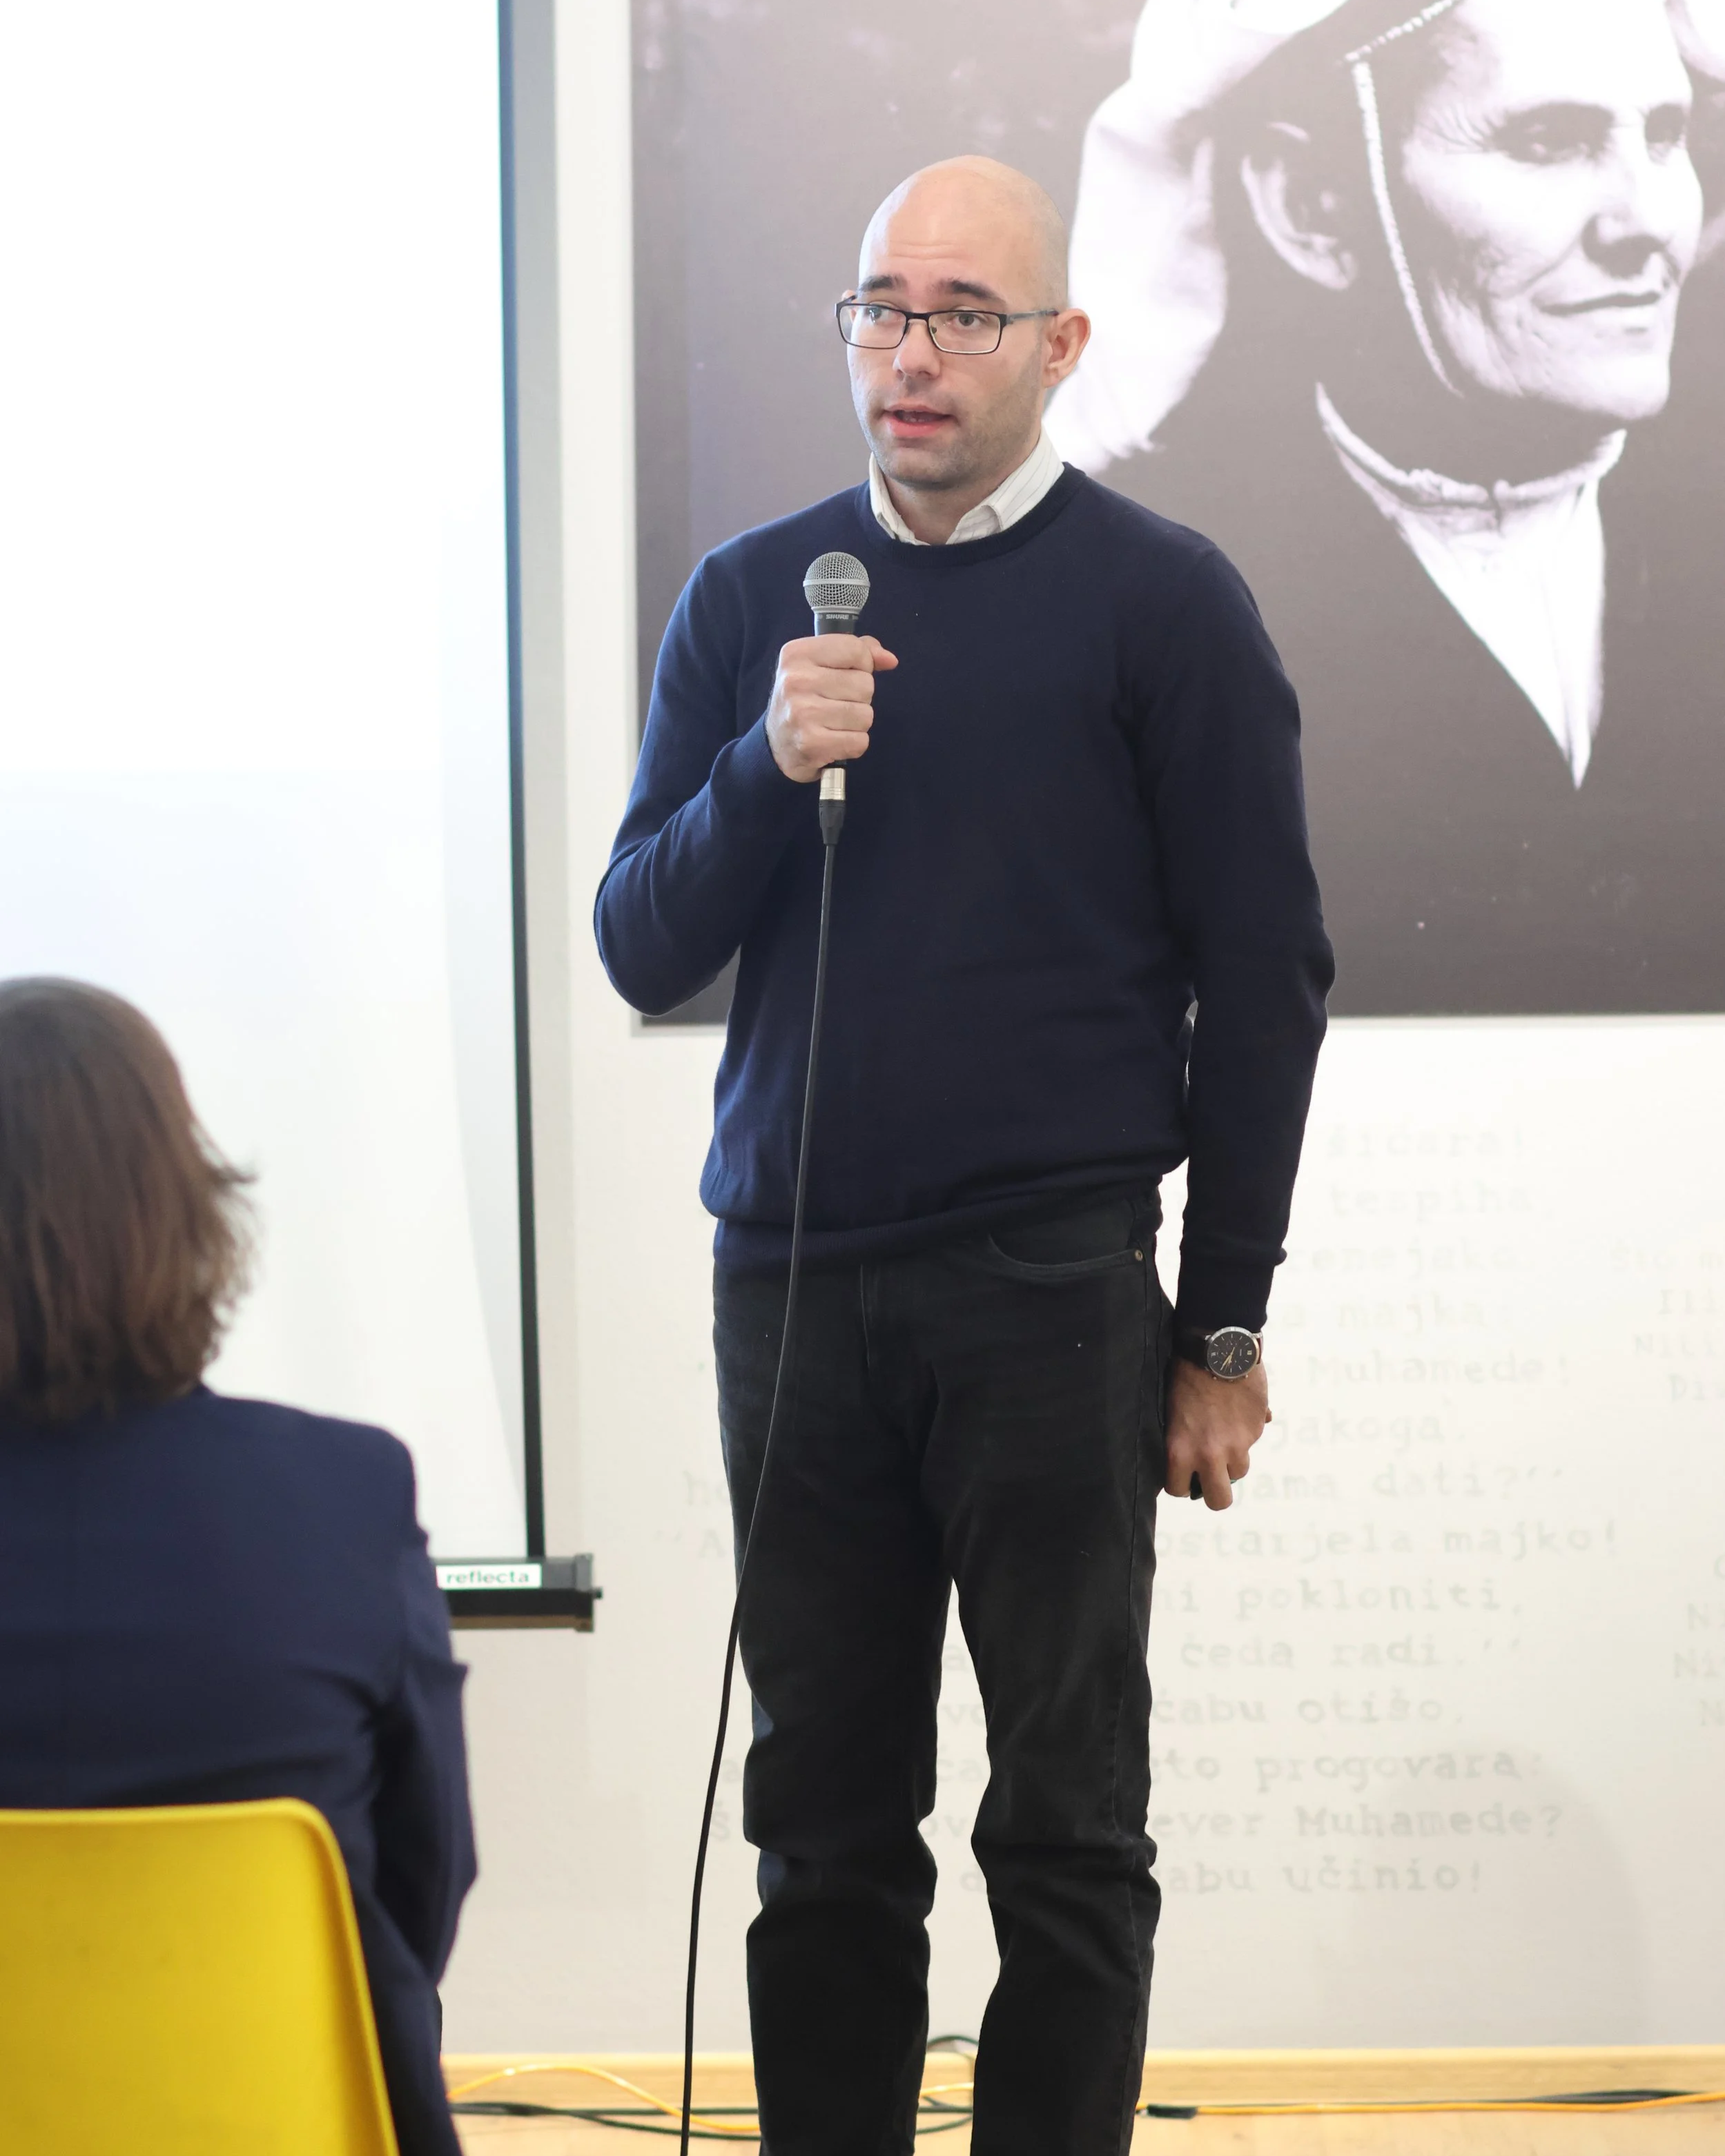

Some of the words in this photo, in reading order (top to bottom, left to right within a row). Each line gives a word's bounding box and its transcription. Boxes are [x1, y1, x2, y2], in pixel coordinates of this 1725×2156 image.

[1307, 1347, 1570, 1389] Muhamede!
[1443, 1517, 1619, 1563] majko!
[446, 1569, 530, 1585] reflecta
[1236, 1576, 1524, 1624] pokloniti,
[1294, 1801, 1564, 1840] Muhamede?
[1154, 1860, 1256, 1896] abu
[1282, 1853, 1484, 1895] učinio!
